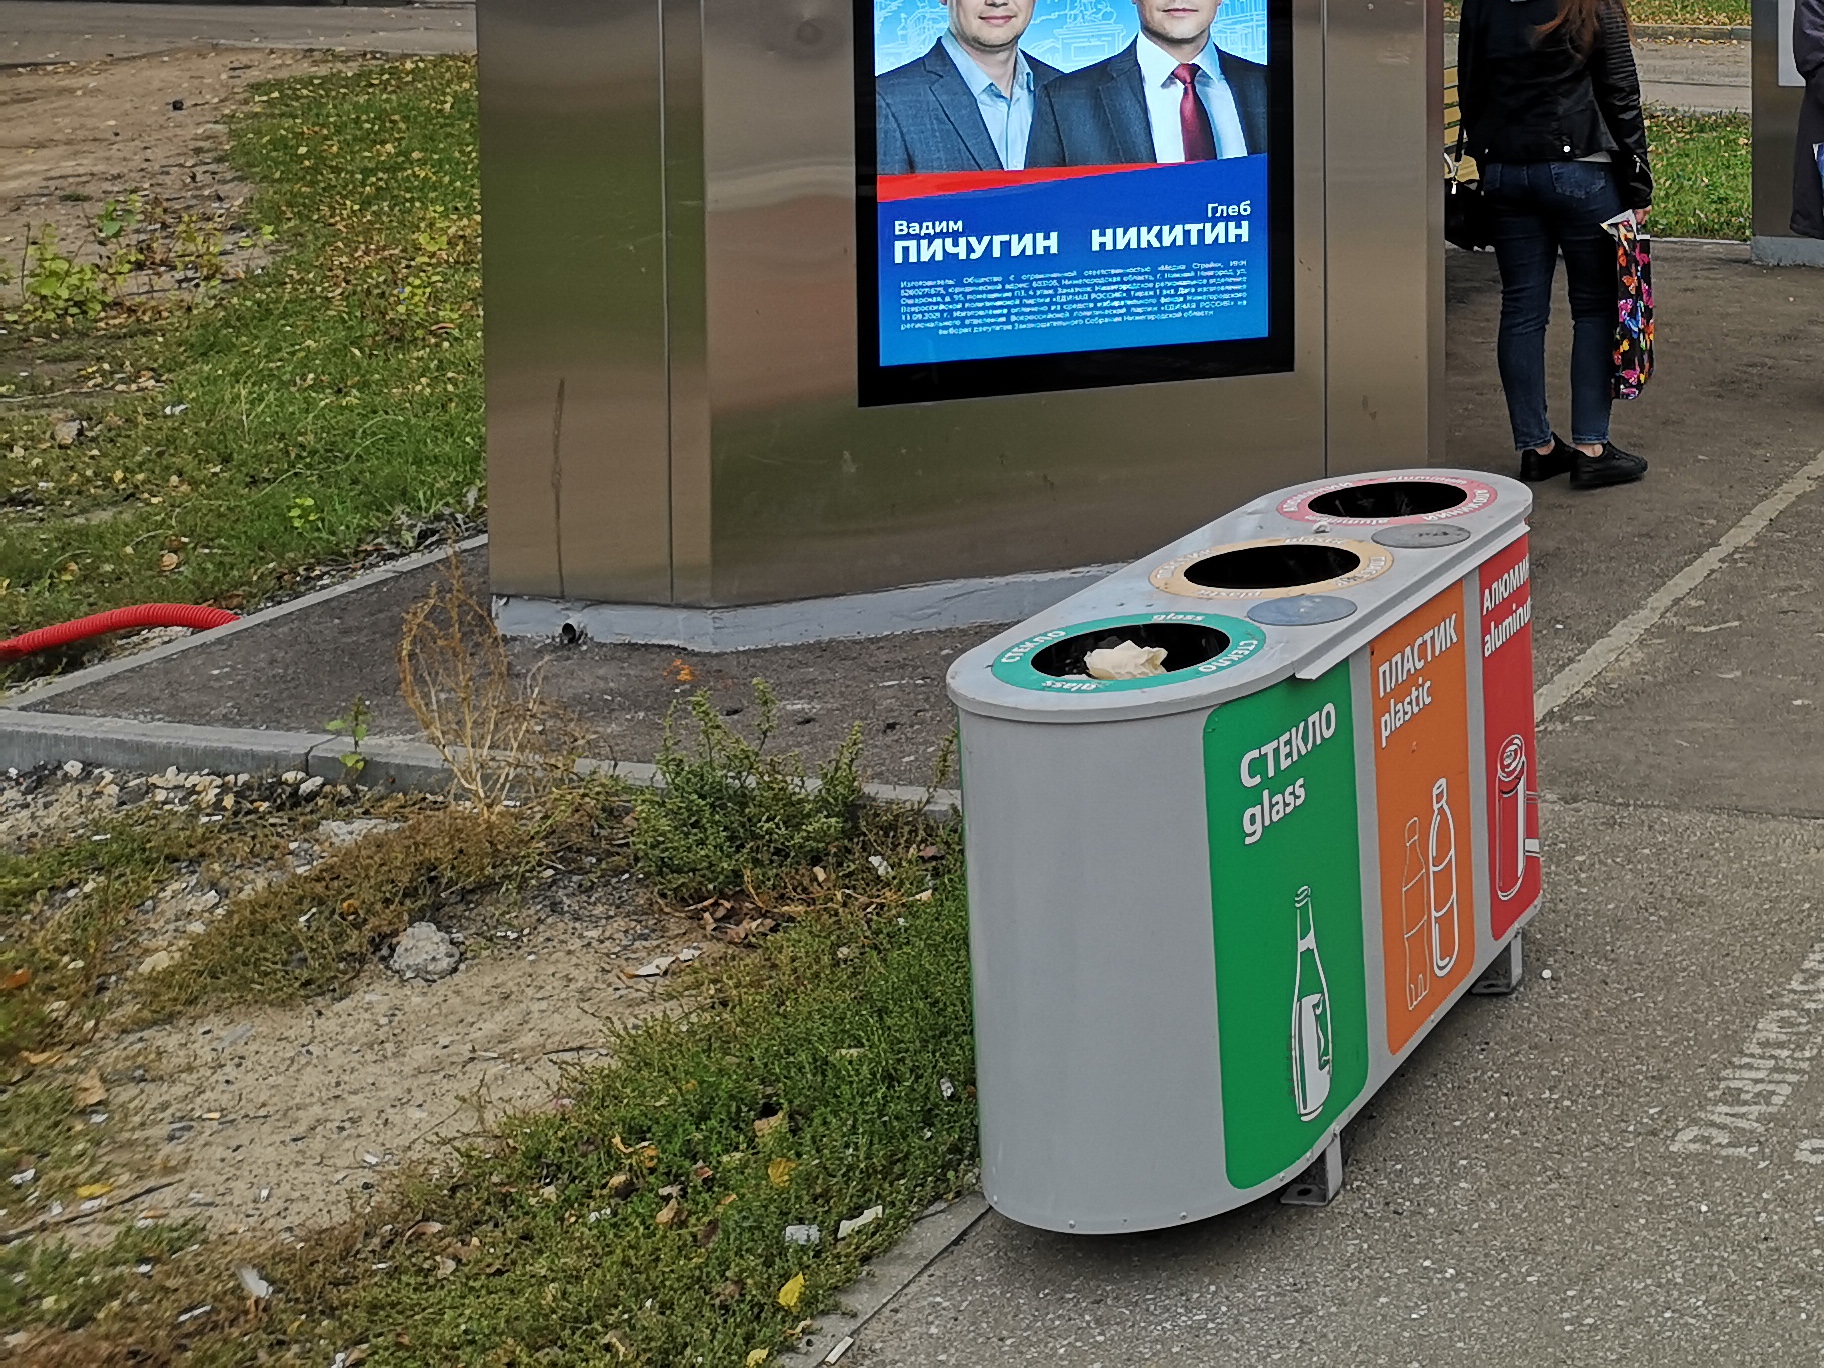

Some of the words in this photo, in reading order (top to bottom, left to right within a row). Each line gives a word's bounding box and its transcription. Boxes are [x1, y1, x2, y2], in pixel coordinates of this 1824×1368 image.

[1207, 200, 1252, 218] Глеб
[894, 219, 963, 236] Вадим
[1091, 220, 1250, 252] НИКИТИН
[894, 232, 1059, 264] ПИЧУГИН
[1151, 613, 1206, 623] glass
[1000, 630, 1067, 664] СТЕКЛО
[1198, 638, 1260, 673] СТЕКЛО
[1377, 612, 1460, 699] ПЛАСТИК
[1041, 679, 1098, 692] glass
[1380, 674, 1434, 749] plastic
[1239, 701, 1338, 791] СТЕКЛО
[1242, 776, 1307, 847] glass
